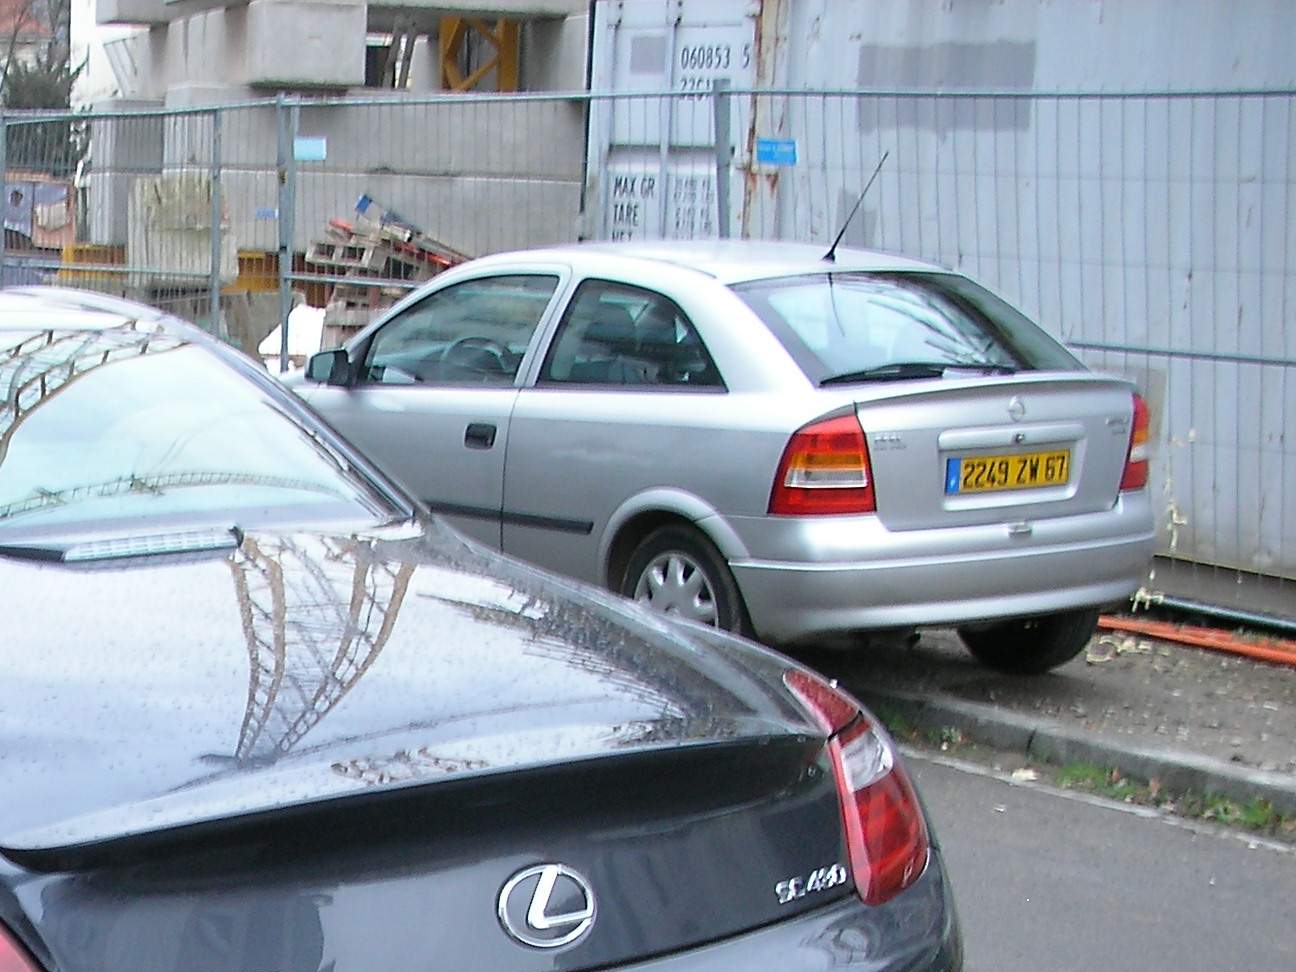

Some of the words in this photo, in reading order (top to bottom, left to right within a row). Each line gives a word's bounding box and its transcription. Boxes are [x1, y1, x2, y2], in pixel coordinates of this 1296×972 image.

[680, 46, 730, 71] 060853
[742, 43, 750, 69] 5
[613, 174, 636, 197] MAX
[640, 176, 655, 197] GR
[612, 202, 639, 226] TARE
[962, 461, 1009, 489] 2249
[1015, 457, 1040, 482] ZW
[1044, 454, 1065, 480] 67
